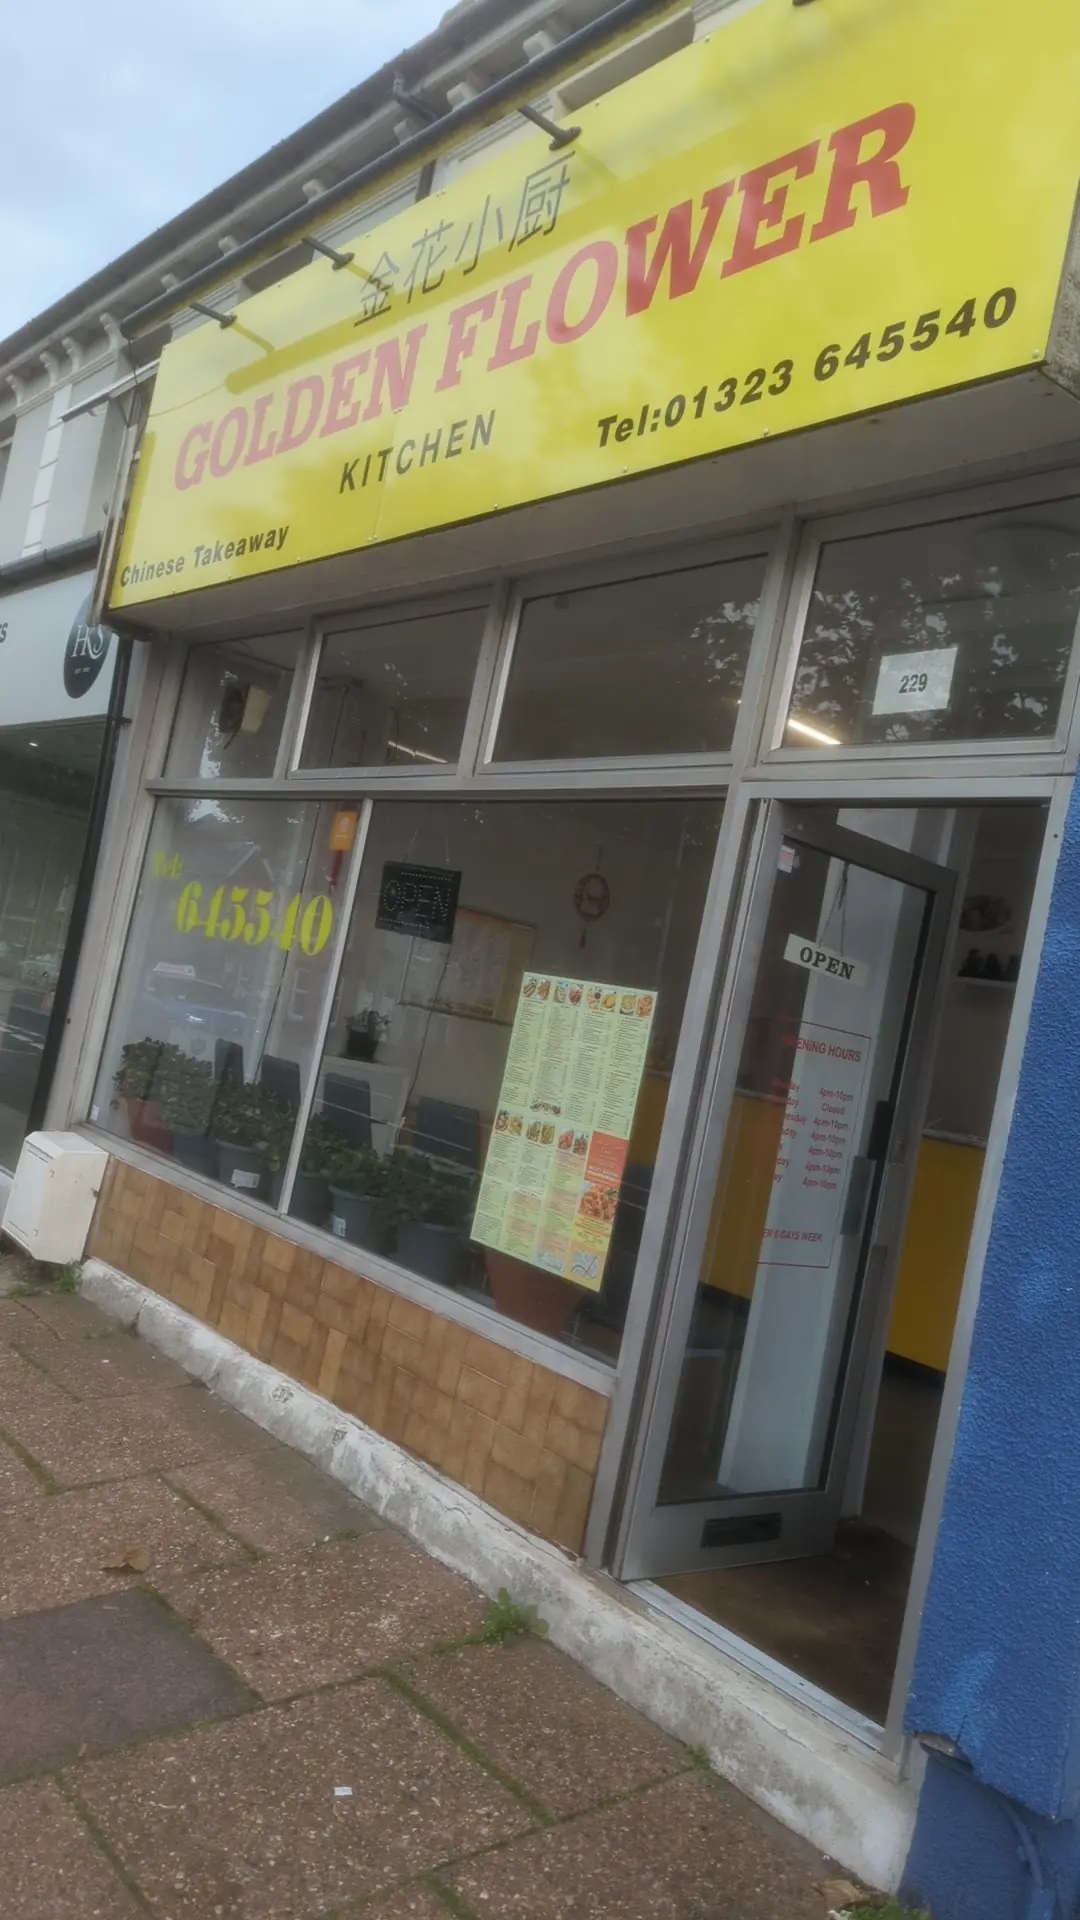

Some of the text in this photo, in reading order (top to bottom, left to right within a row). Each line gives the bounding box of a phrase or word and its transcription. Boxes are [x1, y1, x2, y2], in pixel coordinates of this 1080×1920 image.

[354, 150, 576, 327] 金花小厨
[174, 102, 916, 491] GOLDEN FLOWER
[813, 286, 1017, 381] 645540
[339, 409, 496, 494] KITCHEN
[120, 525, 290, 587] Chinese Takeaway
[898, 672, 928, 694] 229
[177, 880, 333, 956] 645540
[384, 880, 452, 921] OPEN
[799, 946, 856, 980] OPEN
[828, 1043, 862, 1062] HOURS
[801, 1231, 823, 1242] WEEK
